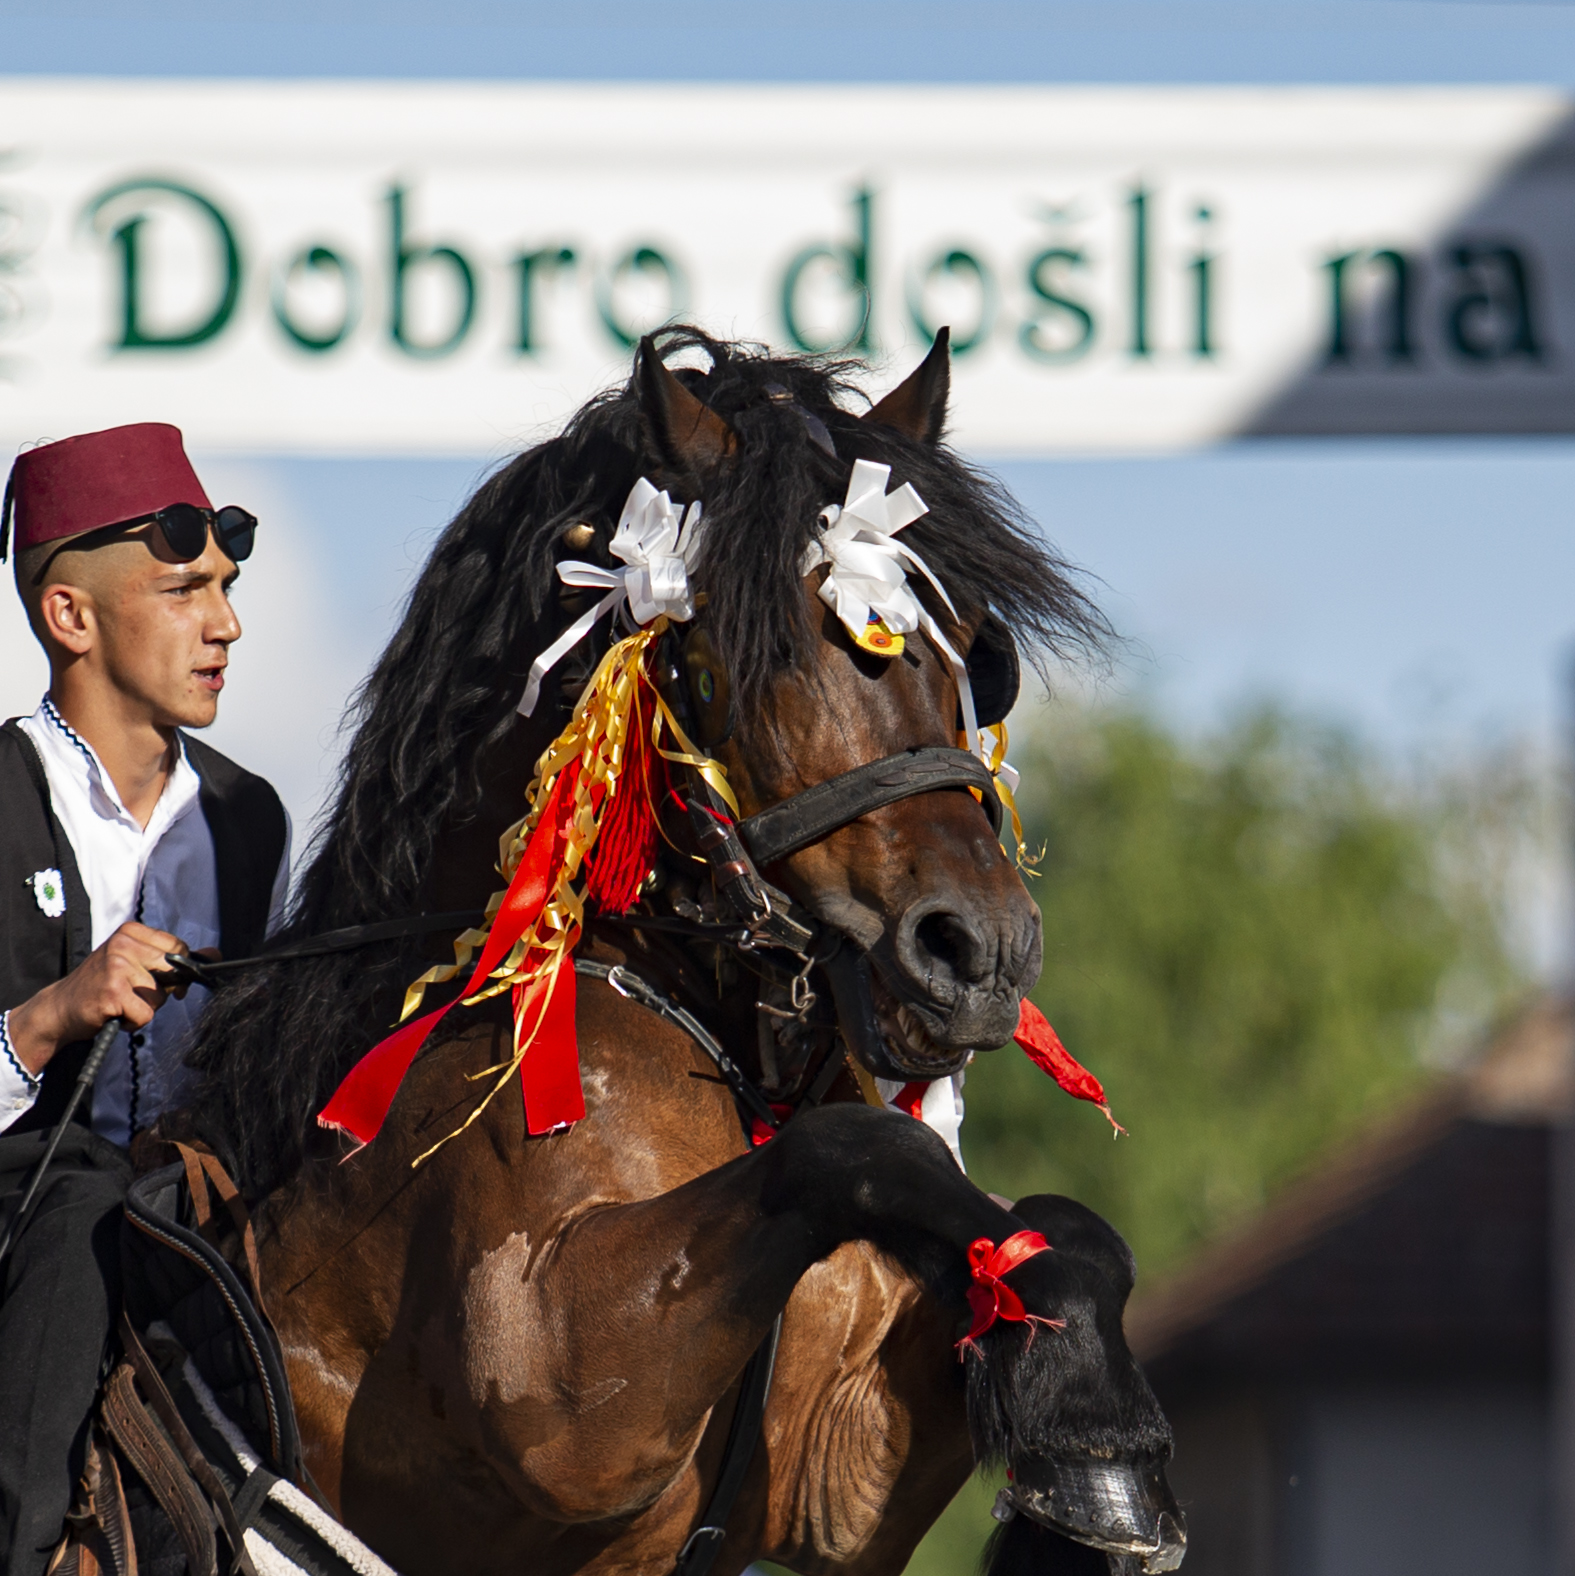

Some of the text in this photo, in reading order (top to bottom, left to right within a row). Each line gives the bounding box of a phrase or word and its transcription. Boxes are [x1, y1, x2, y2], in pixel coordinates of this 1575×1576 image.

[80, 174, 686, 362] Dobro
[774, 178, 1224, 362] došli
[1319, 232, 1549, 366] na
